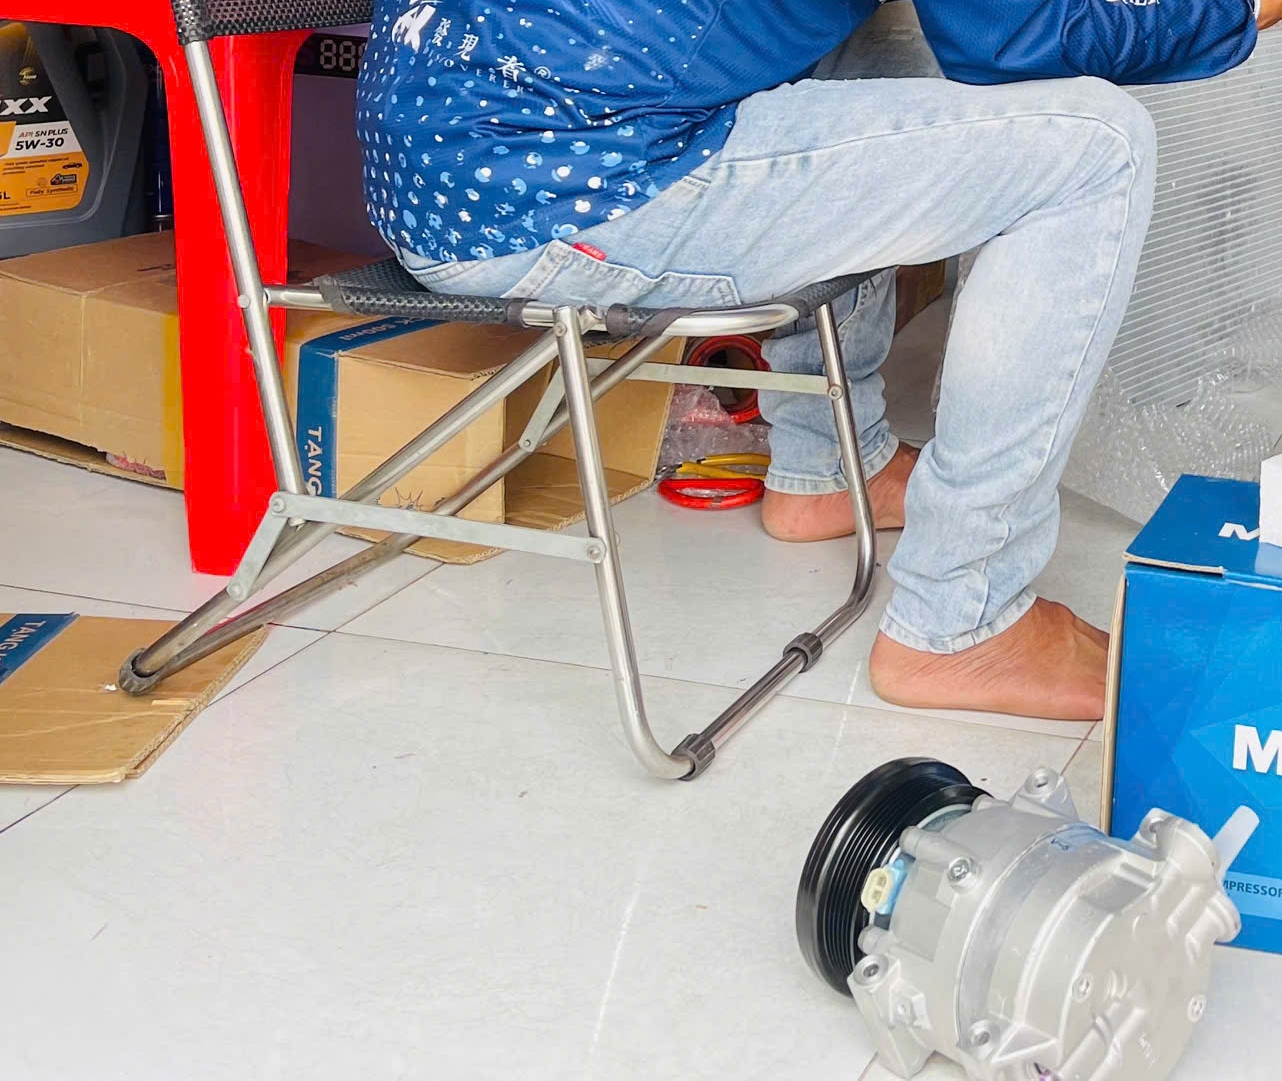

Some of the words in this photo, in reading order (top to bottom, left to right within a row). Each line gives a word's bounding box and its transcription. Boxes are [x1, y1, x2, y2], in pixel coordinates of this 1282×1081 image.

[0, 95, 53, 116] xx
[35, 130, 47, 138] SN
[47, 128, 69, 136] PLUS
[15, 137, 65, 151] 5W-30
